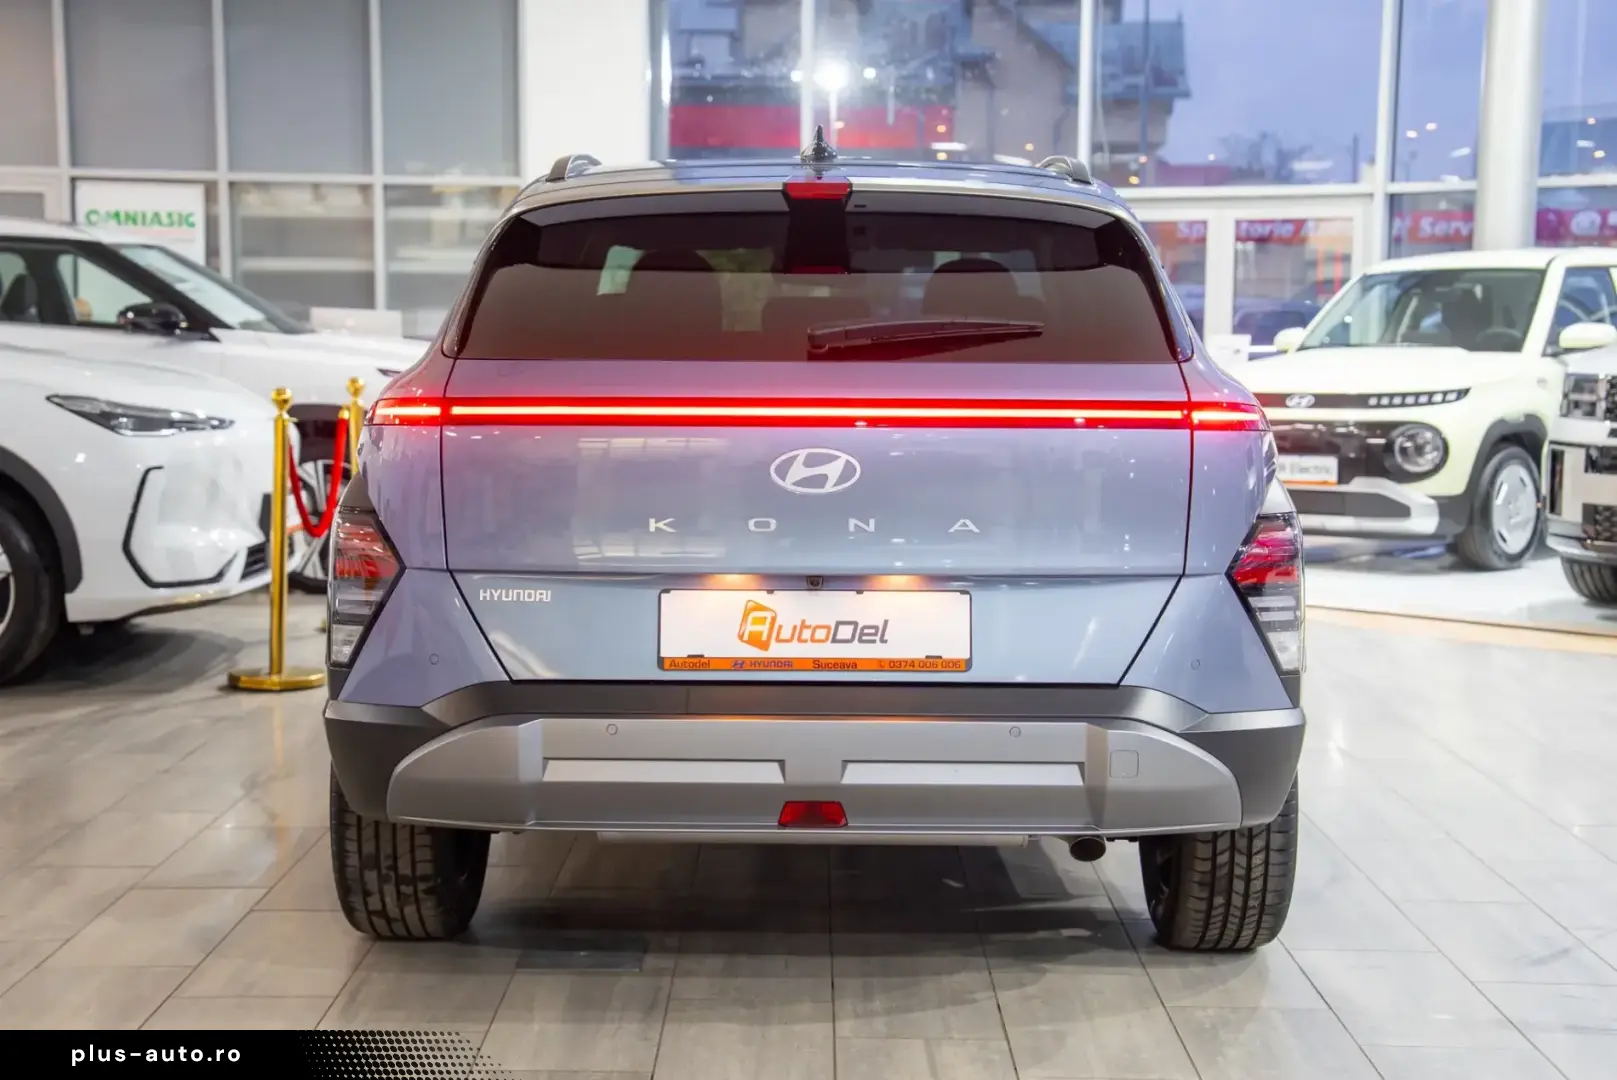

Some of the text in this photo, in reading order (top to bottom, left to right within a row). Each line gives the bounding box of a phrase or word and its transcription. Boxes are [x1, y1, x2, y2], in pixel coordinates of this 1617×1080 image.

[479, 588, 552, 602] HYUNDAI
[741, 609, 890, 645] AutoDel
[669, 659, 711, 669] Autodel
[749, 659, 793, 669] HYUNDAI
[812, 659, 858, 669] Suceava
[888, 660, 915, 669] 0374
